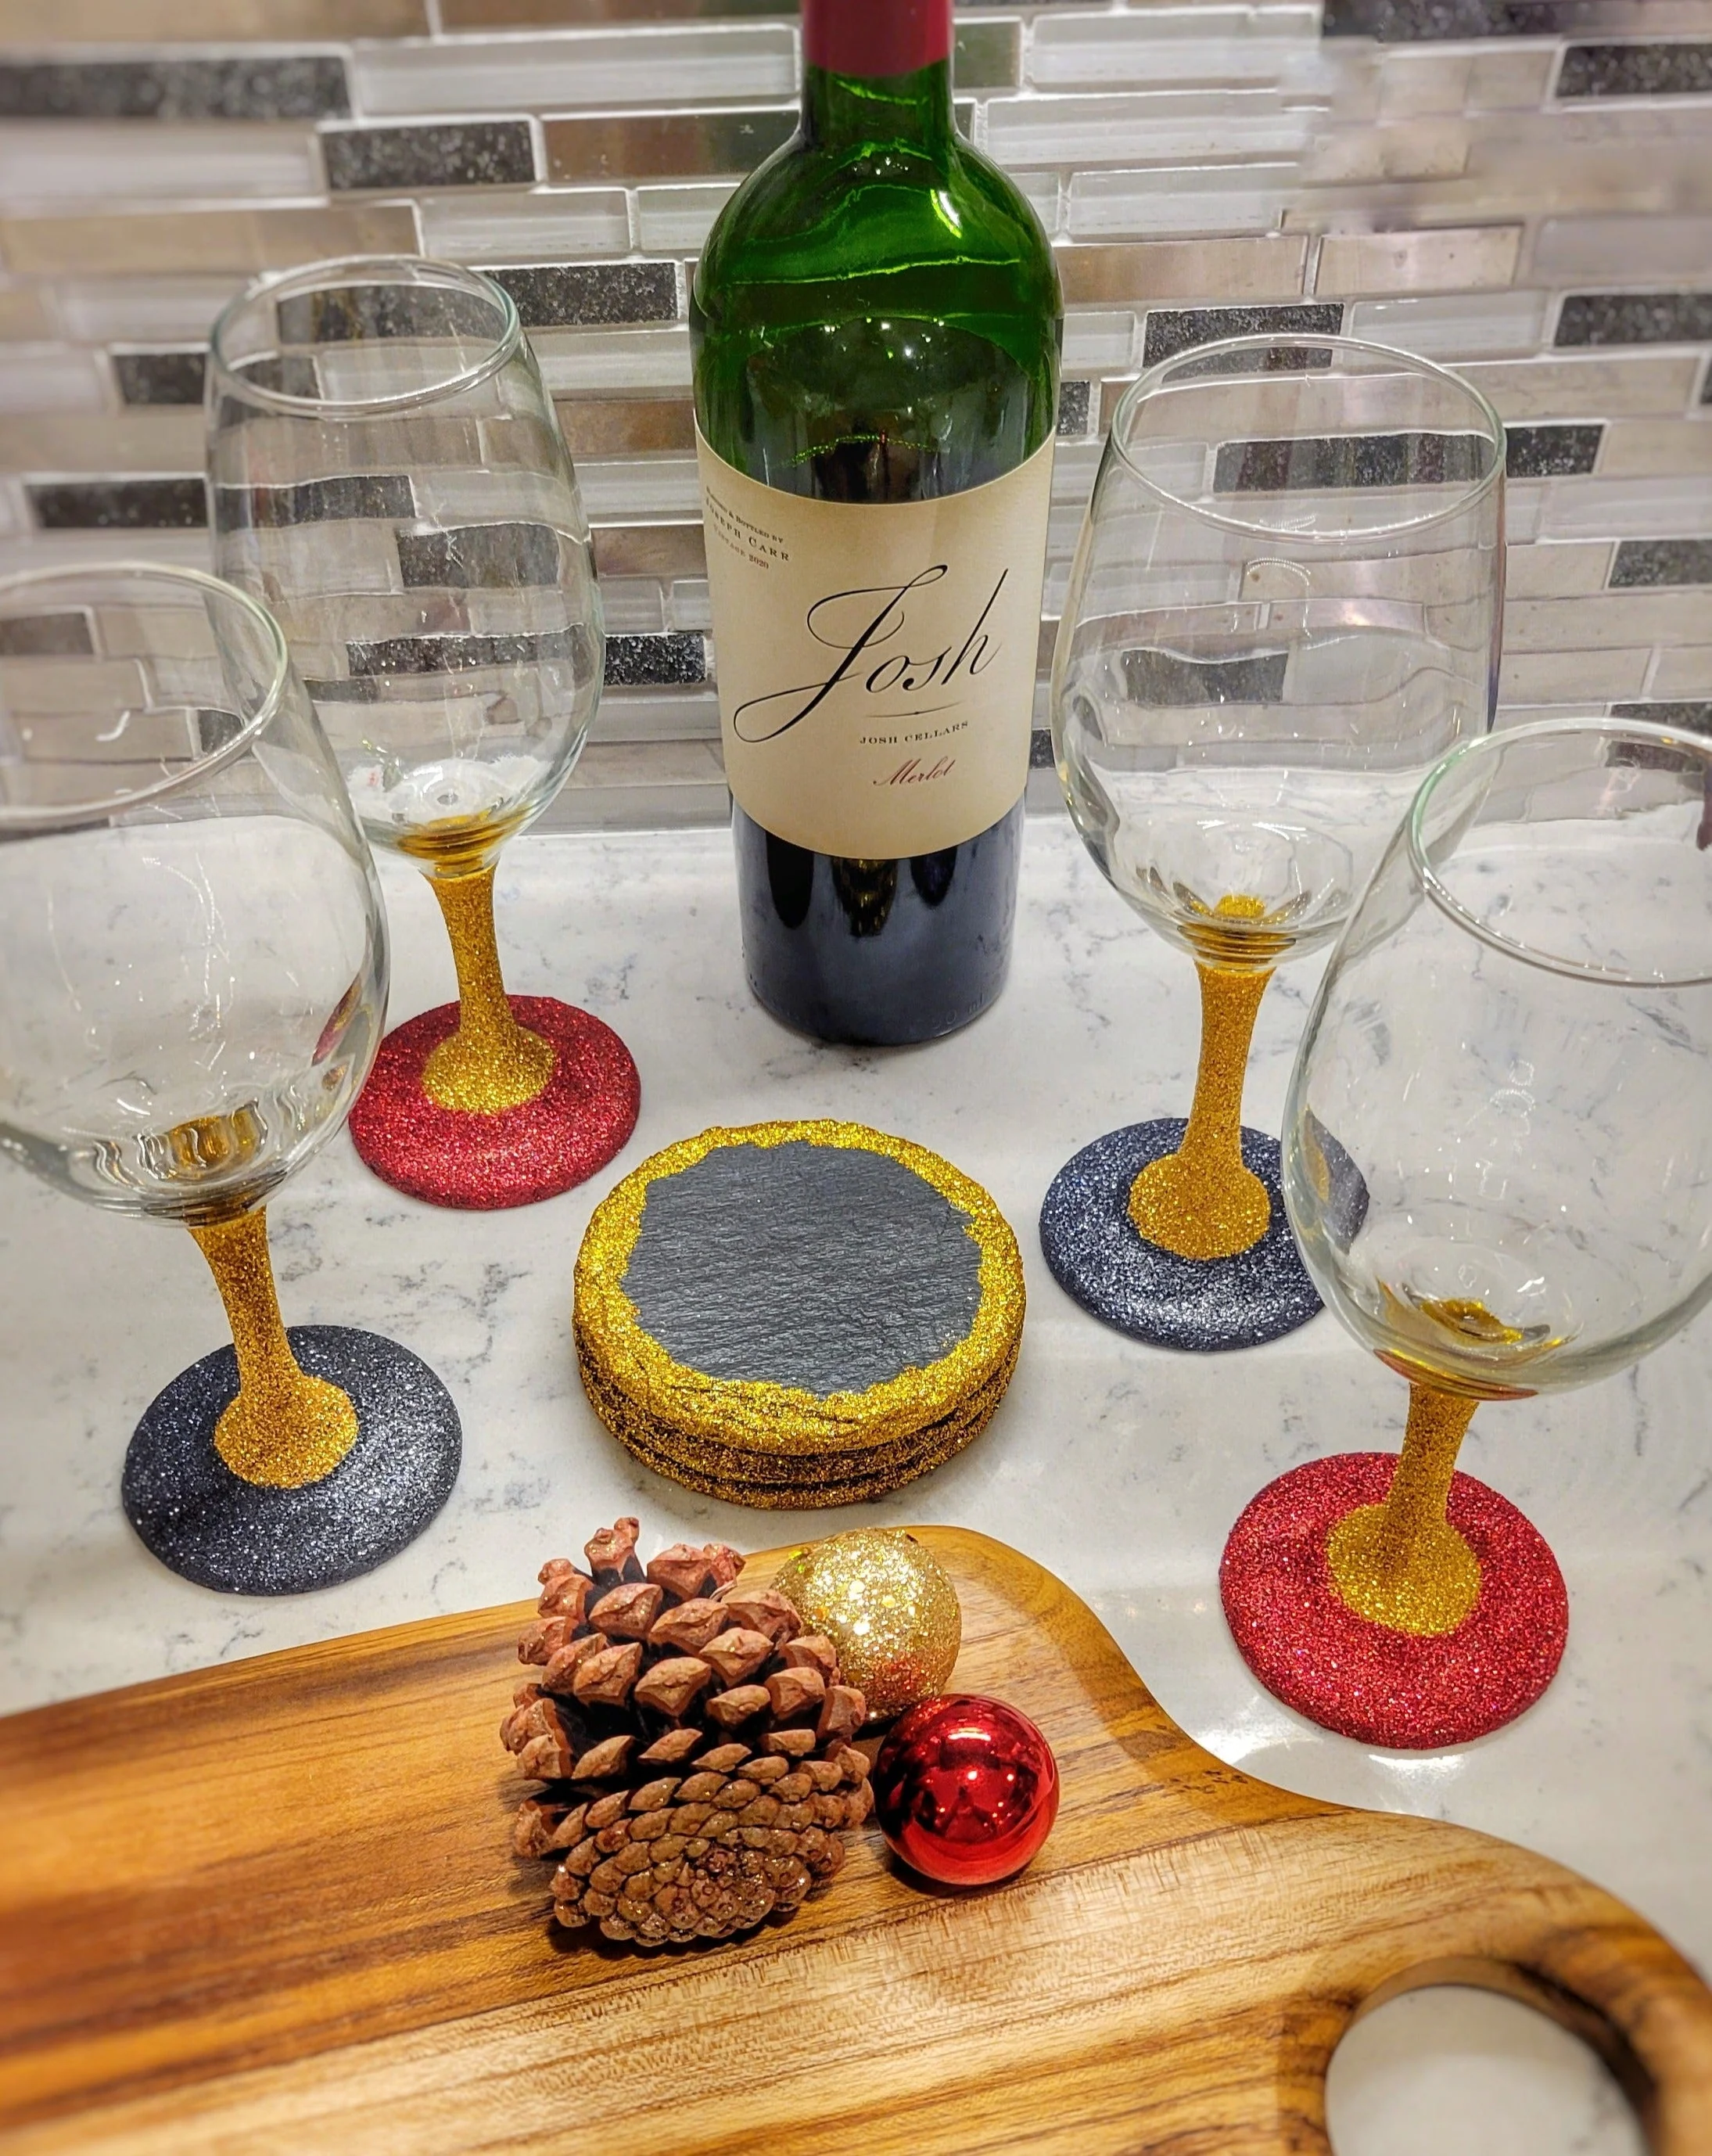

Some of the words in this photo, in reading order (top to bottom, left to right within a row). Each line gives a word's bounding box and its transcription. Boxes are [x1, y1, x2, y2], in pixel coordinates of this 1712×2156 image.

[748, 536, 789, 562] CARR
[772, 535, 784, 544] BY
[748, 554, 770, 570] 2020
[733, 564, 1009, 743] Josh
[904, 720, 968, 742] CELLARS
[872, 755, 956, 786] Merlot
